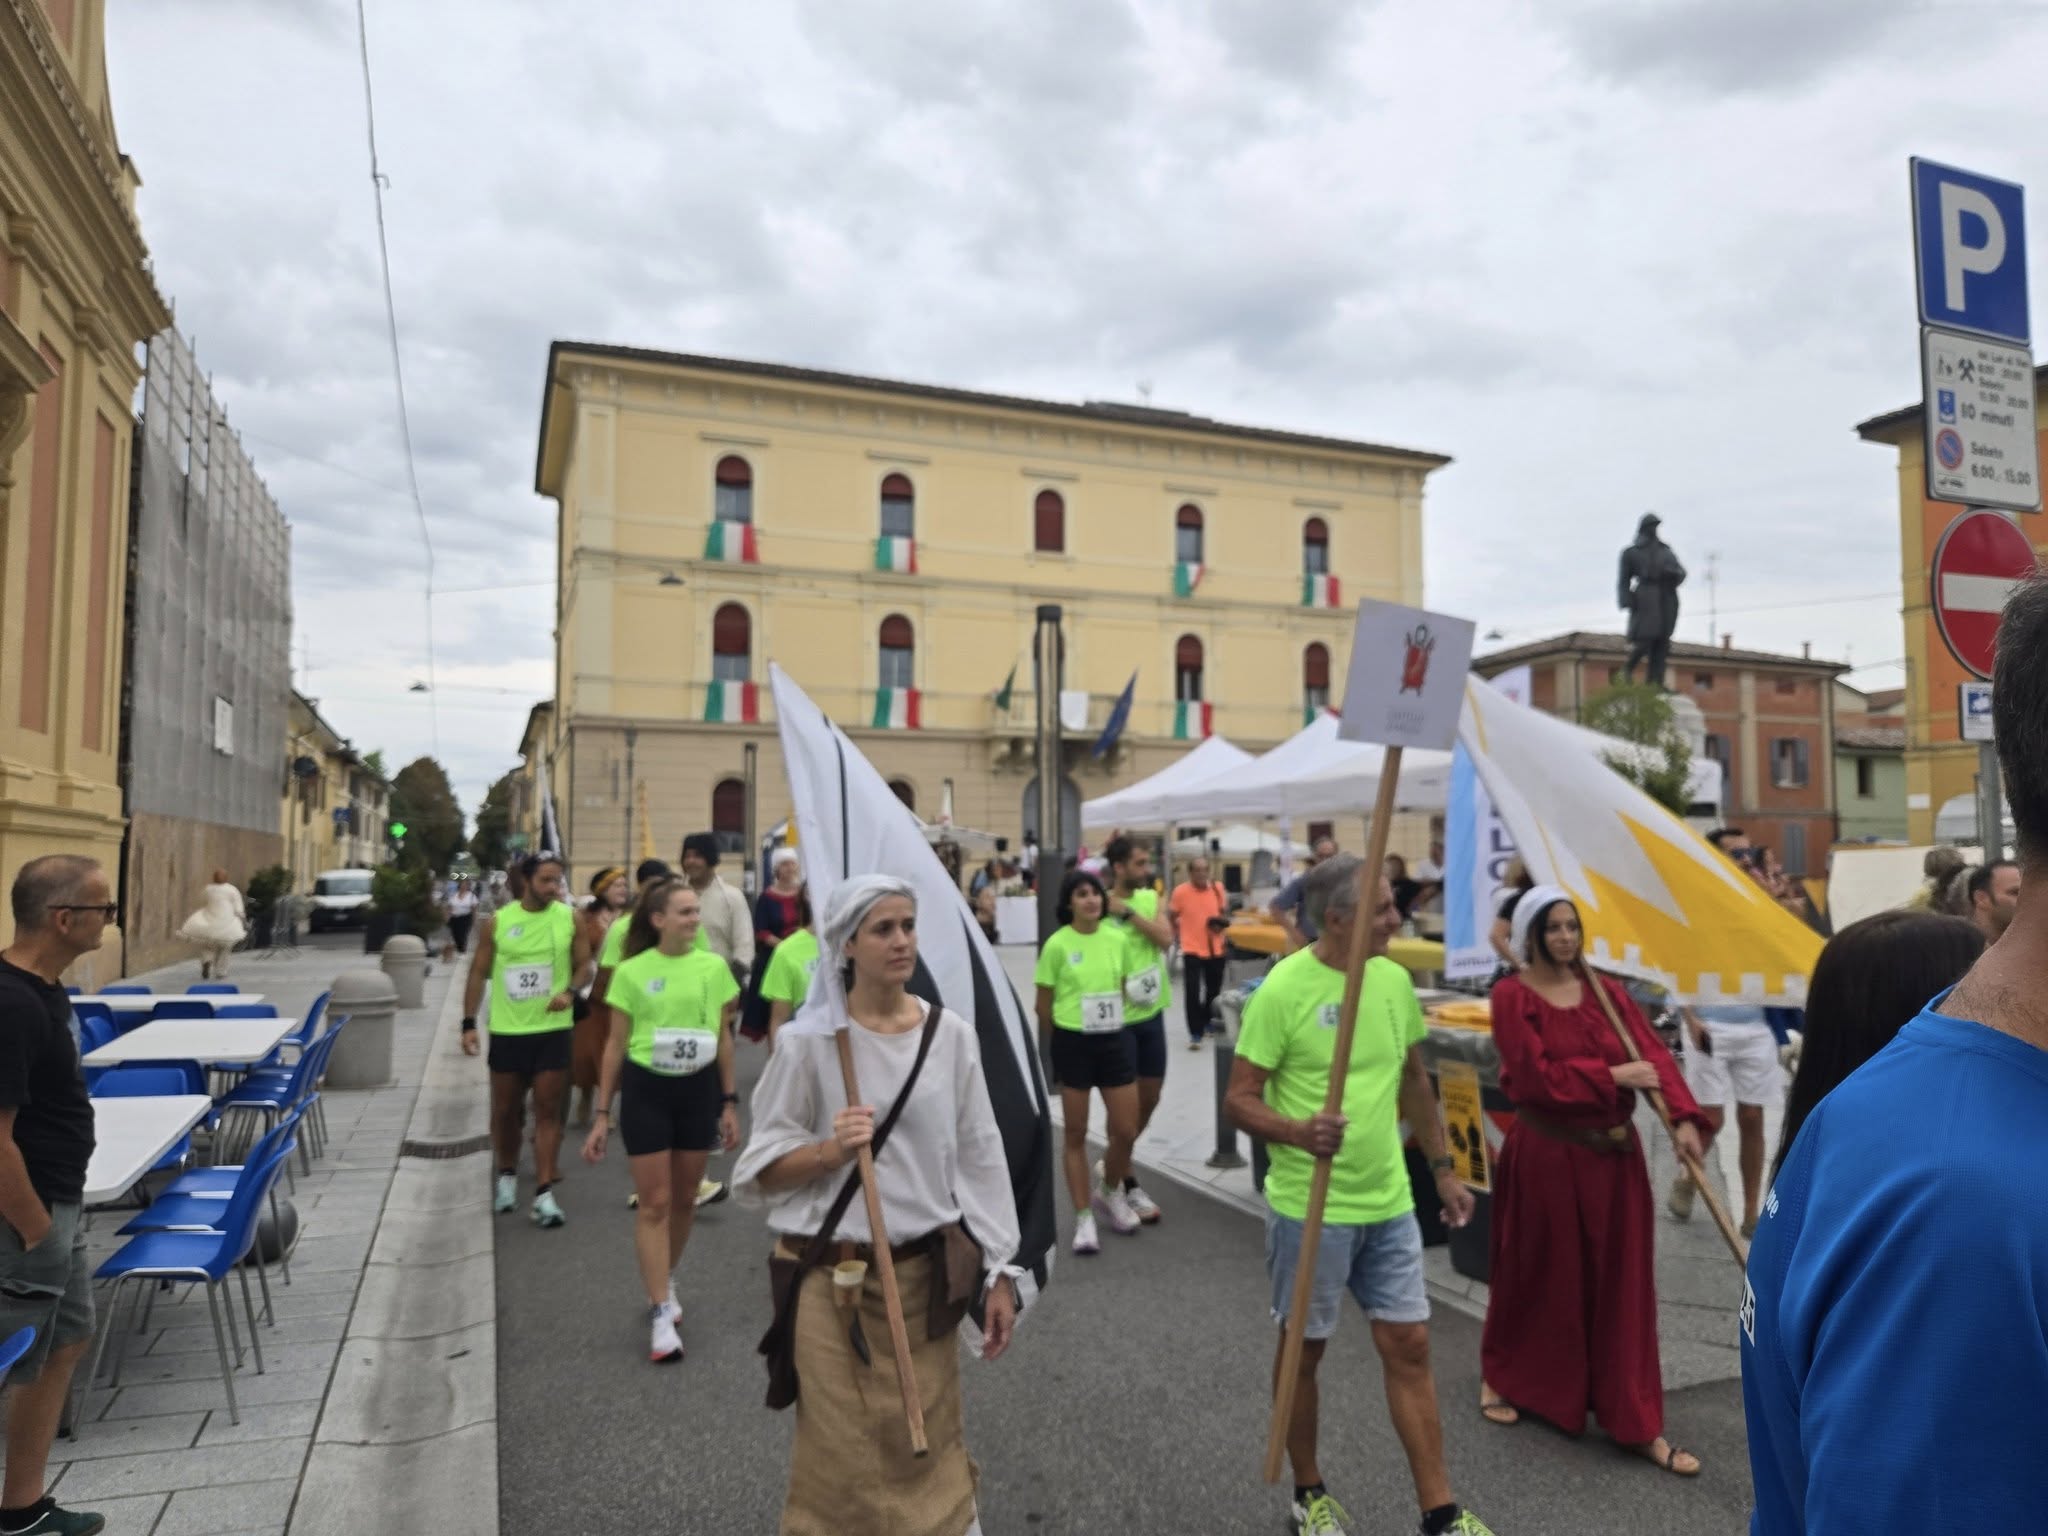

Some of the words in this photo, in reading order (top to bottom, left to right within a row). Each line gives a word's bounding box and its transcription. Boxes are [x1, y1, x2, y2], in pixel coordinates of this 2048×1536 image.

[1939, 181, 2006, 312] P
[1981, 411, 2015, 427] minuti
[1970, 441, 2004, 459] Sabato
[520, 972, 539, 988] 32
[1097, 1001, 1114, 1019] 31
[674, 1038, 698, 1059] 33
